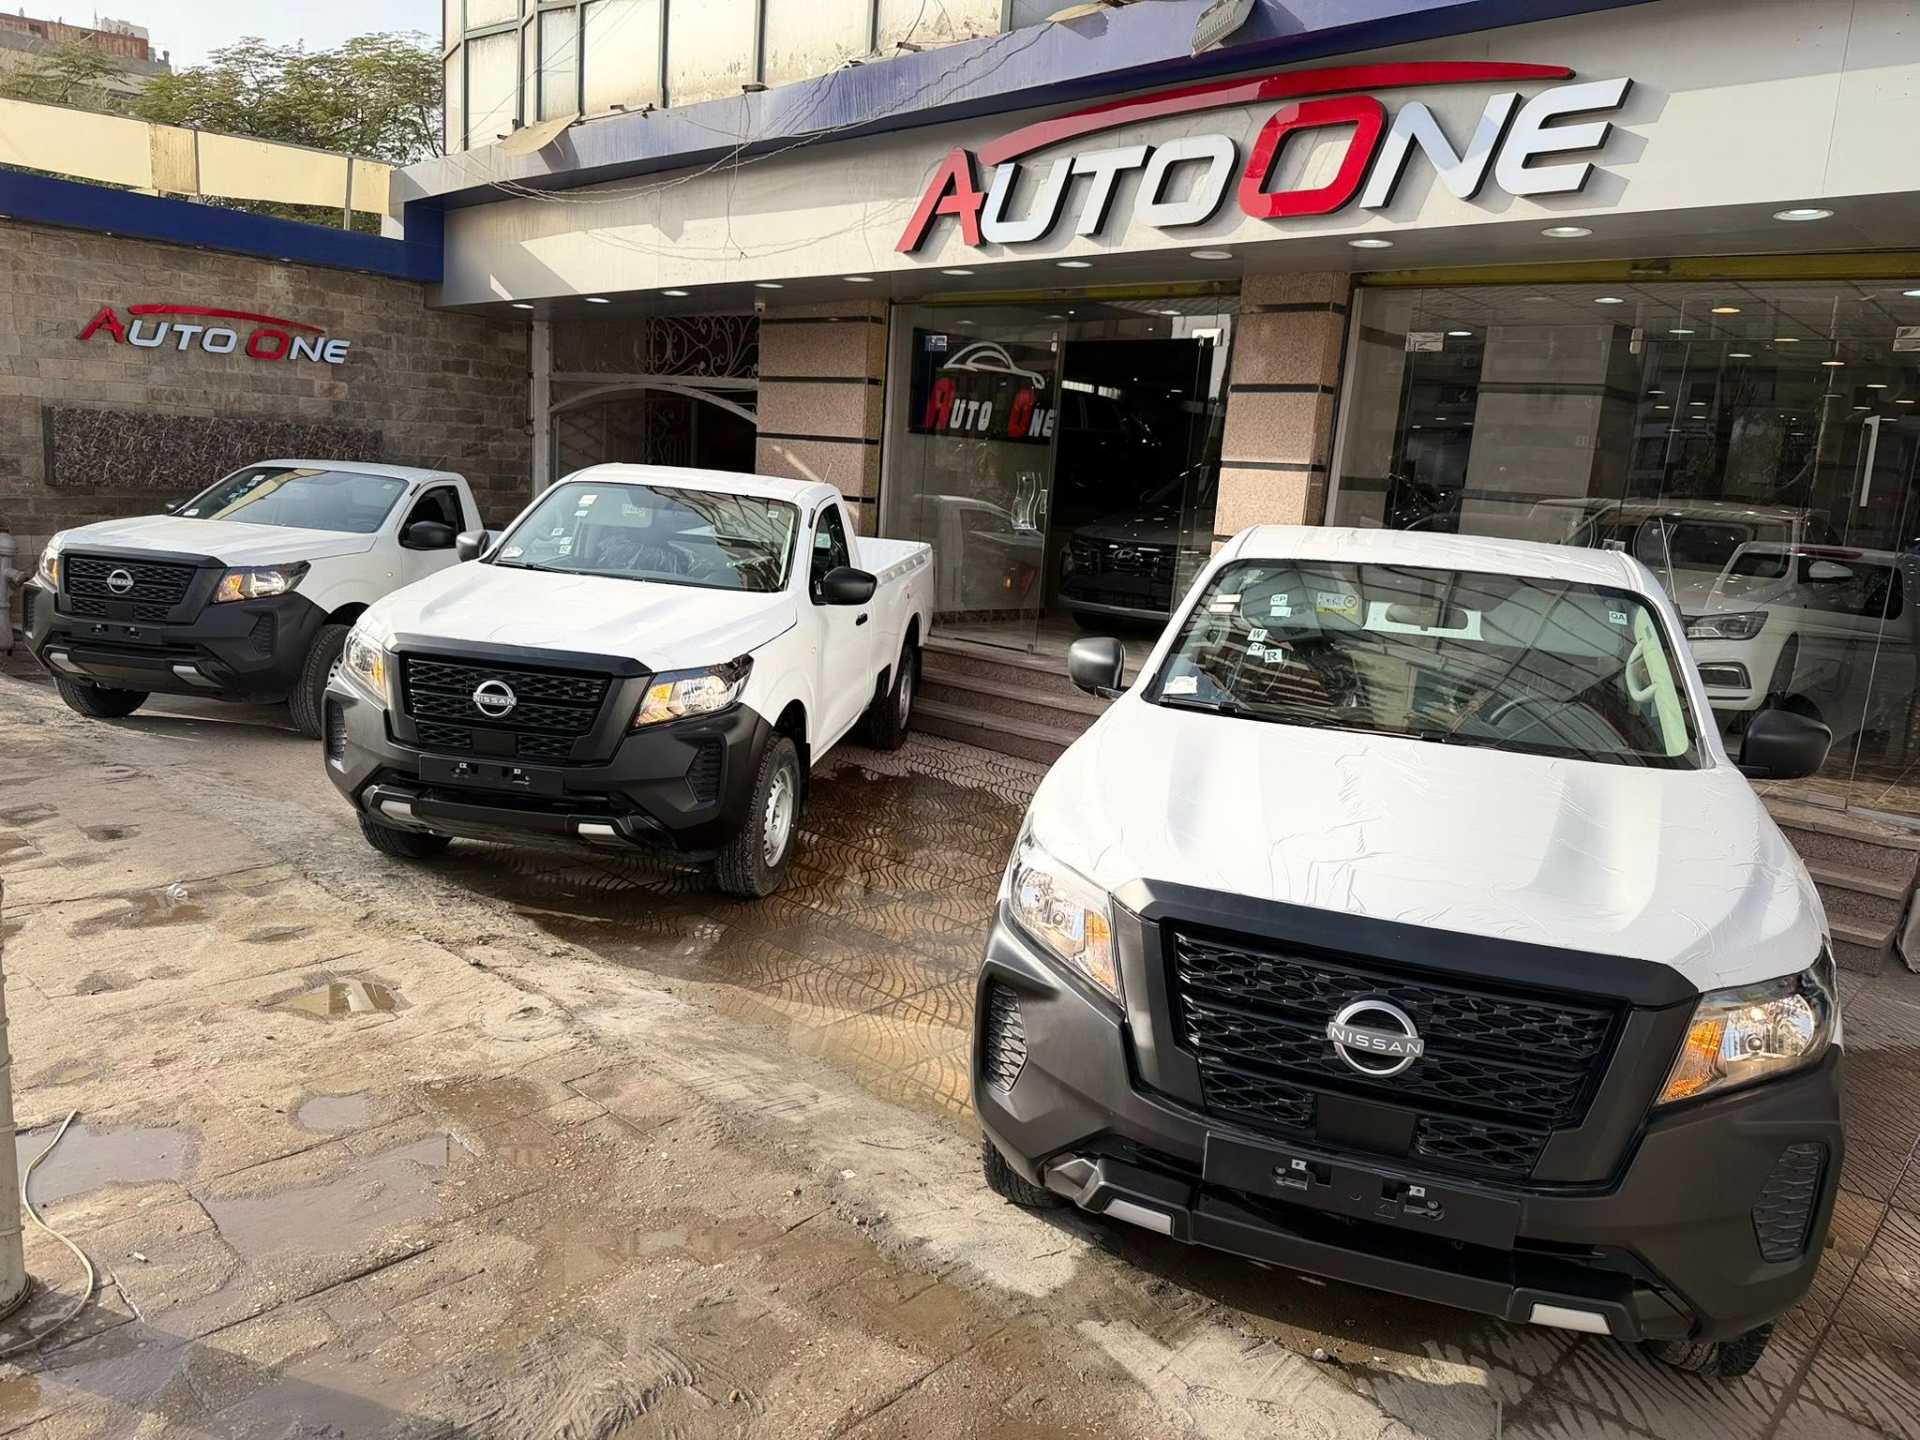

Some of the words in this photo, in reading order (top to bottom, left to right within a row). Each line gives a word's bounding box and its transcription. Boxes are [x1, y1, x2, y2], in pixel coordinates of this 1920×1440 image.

[894, 134, 1239, 254] AUTO
[1237, 76, 1635, 221] ONE
[77, 305, 238, 355] AUTO
[245, 328, 351, 364] ONE
[926, 377, 993, 432] AUTO
[1266, 651, 1279, 661] R
[473, 693, 516, 706] NISSAN
[1331, 1026, 1422, 1054] NISSAN
